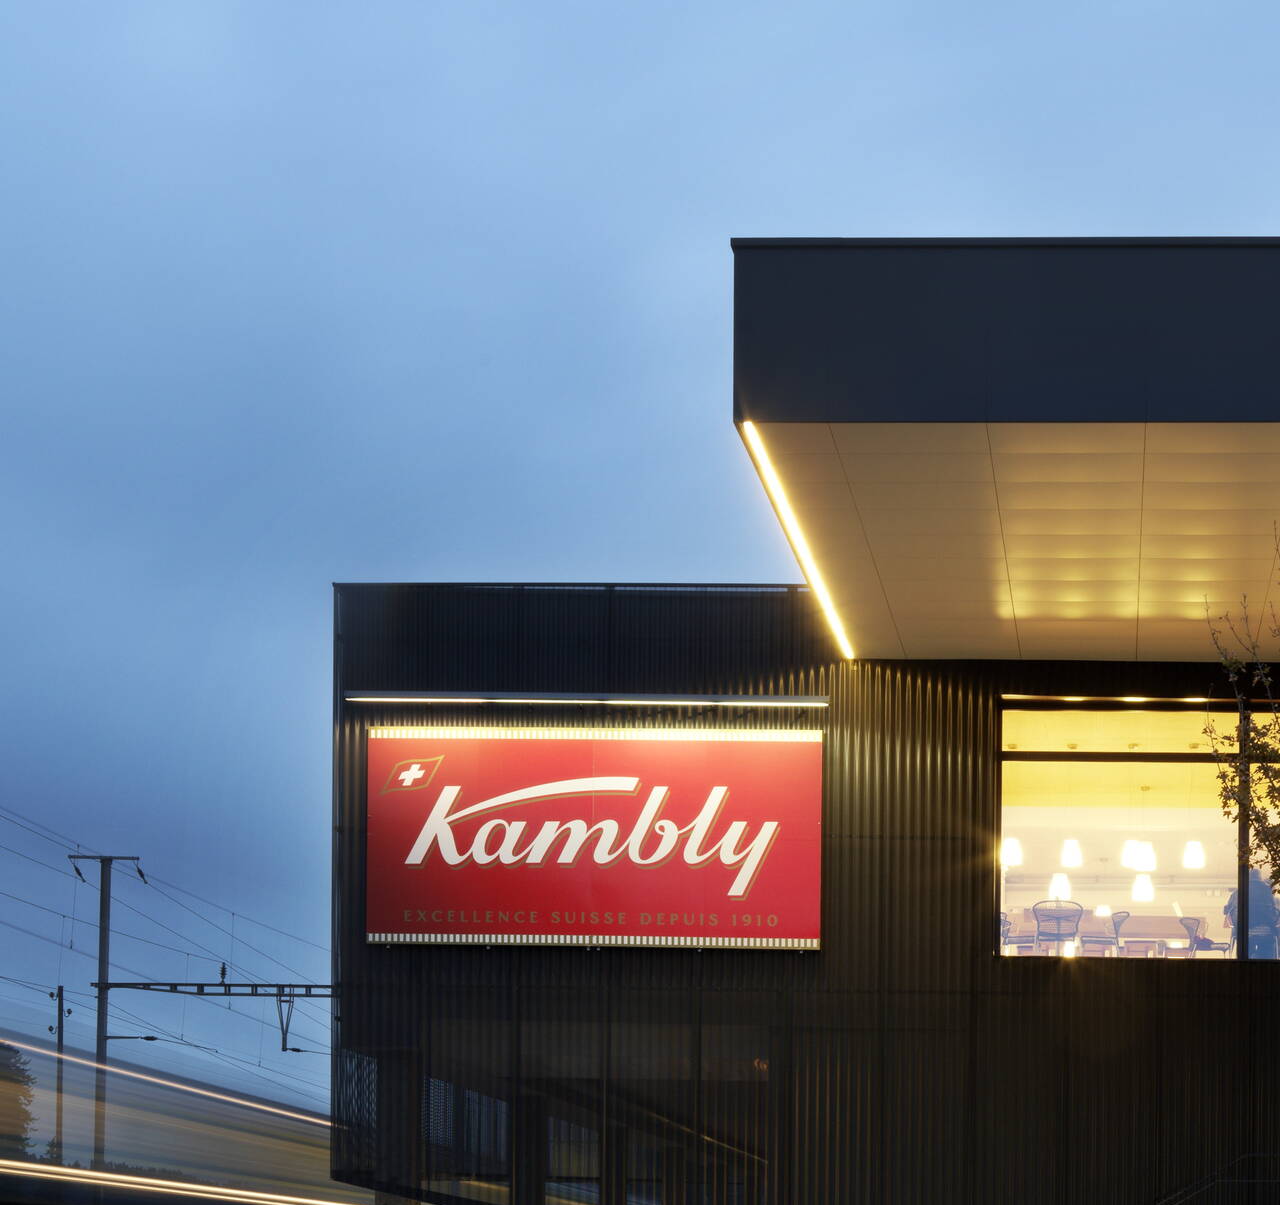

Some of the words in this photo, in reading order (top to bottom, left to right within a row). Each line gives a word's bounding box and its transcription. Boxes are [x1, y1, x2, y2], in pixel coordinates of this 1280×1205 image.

[404, 776, 780, 899] Kambly
[403, 909, 539, 924] EXCELLENCE
[551, 911, 627, 926] SUISSE
[639, 912, 720, 927] DEPUIS
[731, 913, 779, 928] 1910
